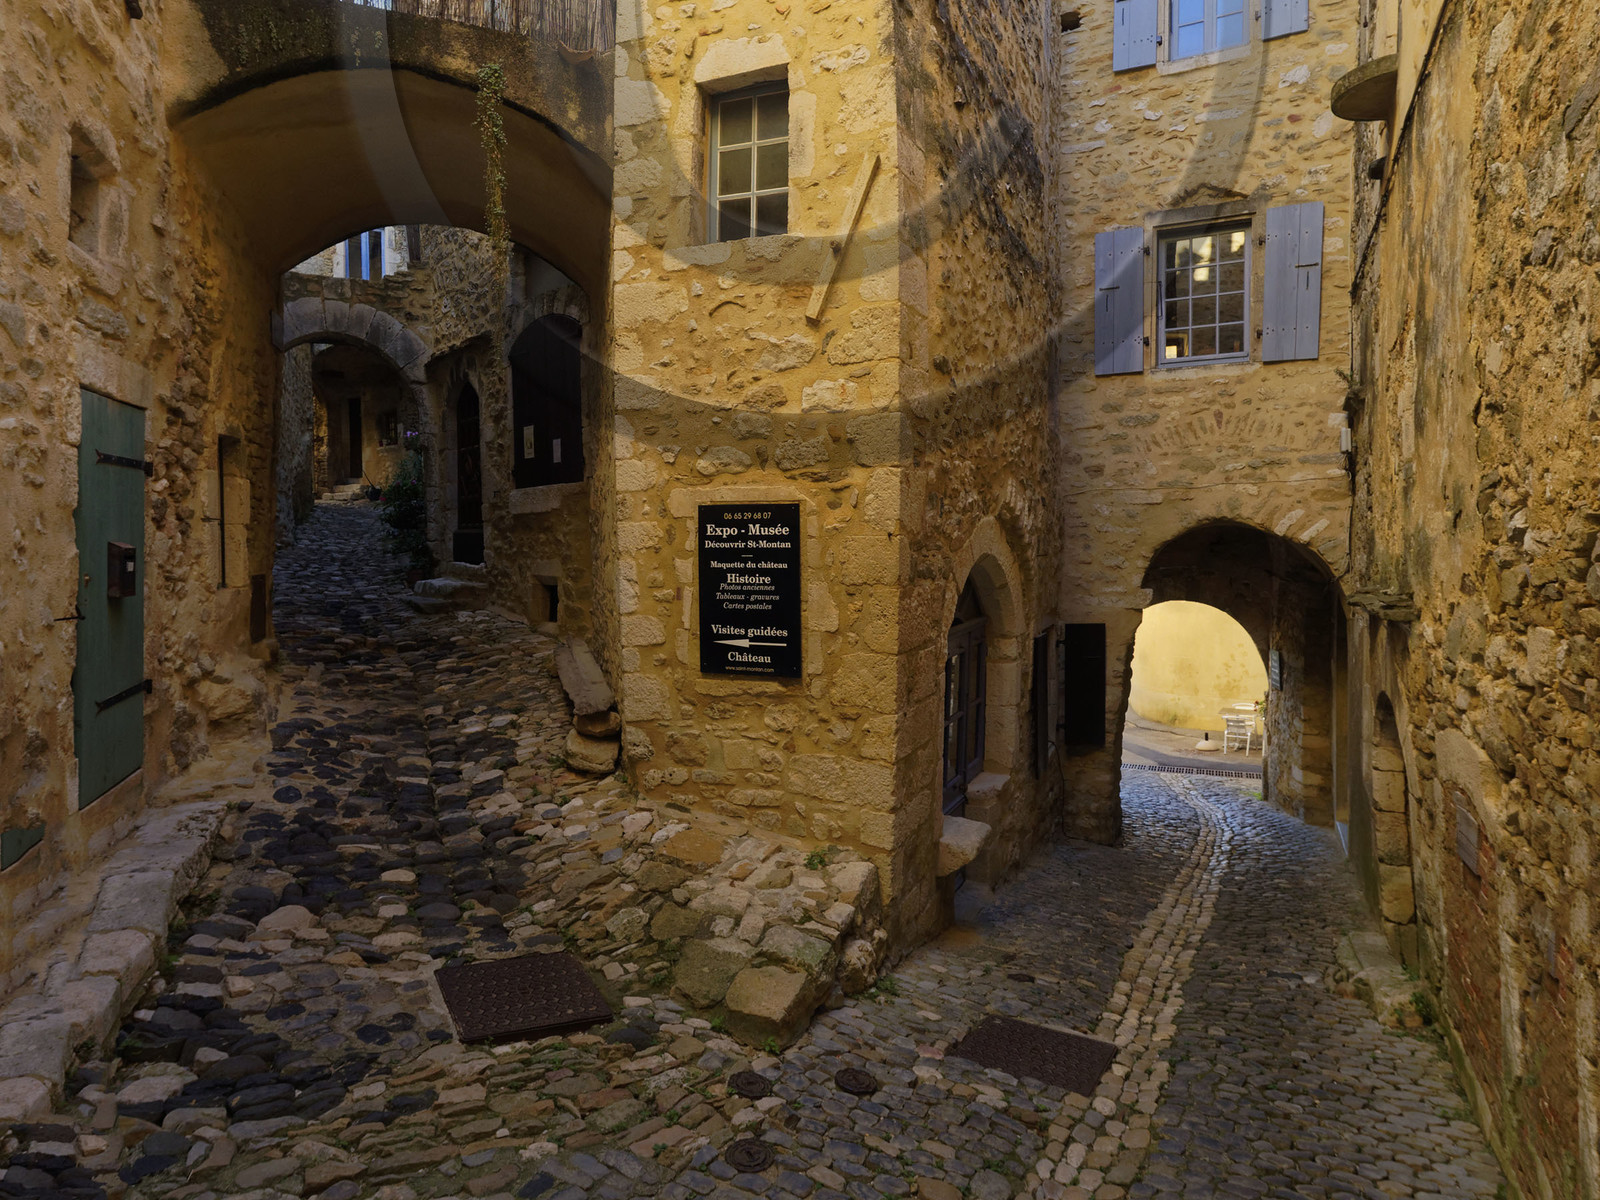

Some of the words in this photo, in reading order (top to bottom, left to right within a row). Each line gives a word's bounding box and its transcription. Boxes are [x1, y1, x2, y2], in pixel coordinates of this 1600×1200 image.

[723, 512, 733, 520] 06
[733, 512, 743, 520] 65
[743, 511, 752, 520] 29
[752, 511, 762, 520] 68
[762, 511, 772, 520] 07
[706, 524, 738, 538] Expo
[748, 523, 790, 536] Musée
[704, 540, 746, 549] Découvrir
[747, 540, 791, 549] St-Montan
[710, 560, 745, 570] Maquette
[746, 560, 756, 569] du
[757, 560, 788, 569] château
[726, 573, 771, 584] Histoire
[719, 583, 742, 591] Photos
[715, 592, 745, 600] Tableaux
[750, 594, 780, 602] gravures
[723, 601, 744, 610] Cartes
[745, 602, 772, 611] postales
[711, 624, 745, 636] Visites
[747, 626, 788, 637] guidées
[727, 651, 771, 663] Château
[725, 665, 775, 673] www.saint-montan.com
